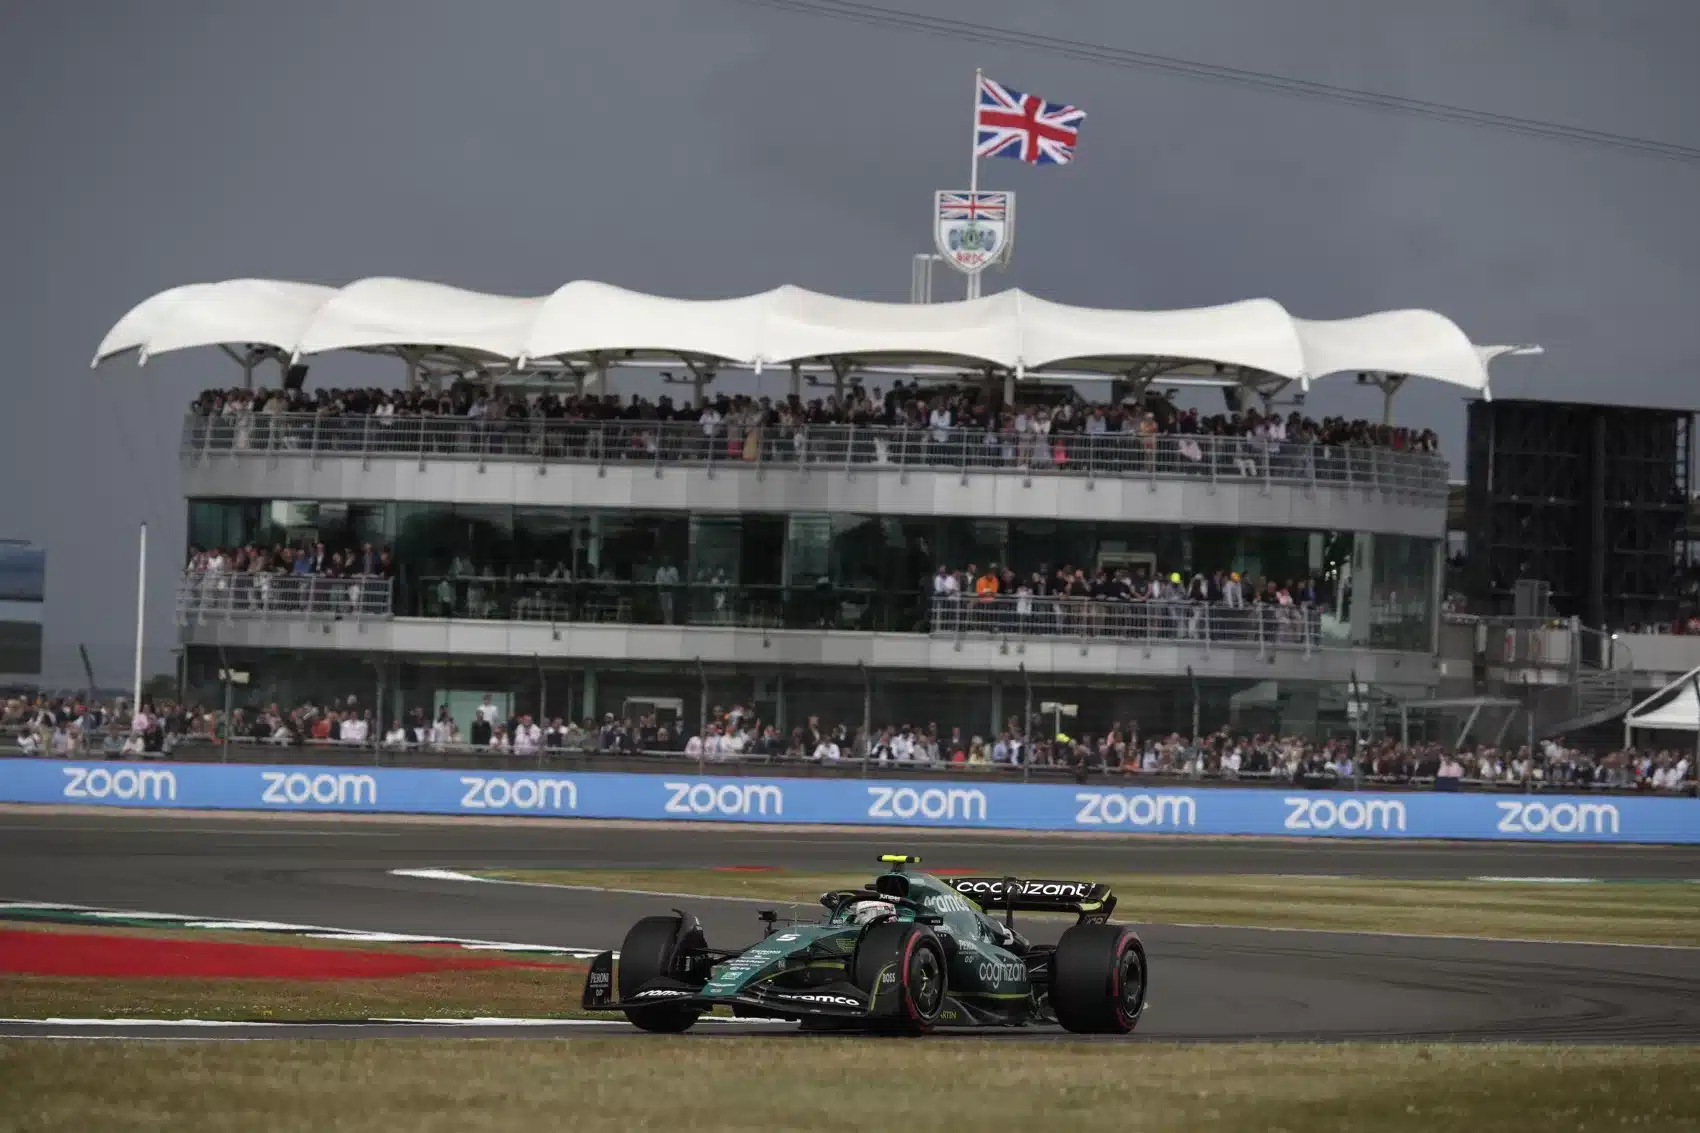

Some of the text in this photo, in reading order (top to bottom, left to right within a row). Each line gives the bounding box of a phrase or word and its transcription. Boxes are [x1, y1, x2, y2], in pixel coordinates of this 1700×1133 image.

[63, 767, 176, 800] zoom
[262, 772, 376, 804] zoom
[460, 777, 577, 809] zoom
[664, 783, 782, 814] zoom
[867, 787, 986, 819] zoom
[1075, 793, 1196, 825] zoom
[1284, 797, 1405, 830] zoom
[1496, 801, 1619, 833] zoom
[776, 933, 802, 942] 5
[590, 972, 610, 984] PERONI
[882, 972, 896, 983] BOSS
[778, 994, 860, 1006] aramco
